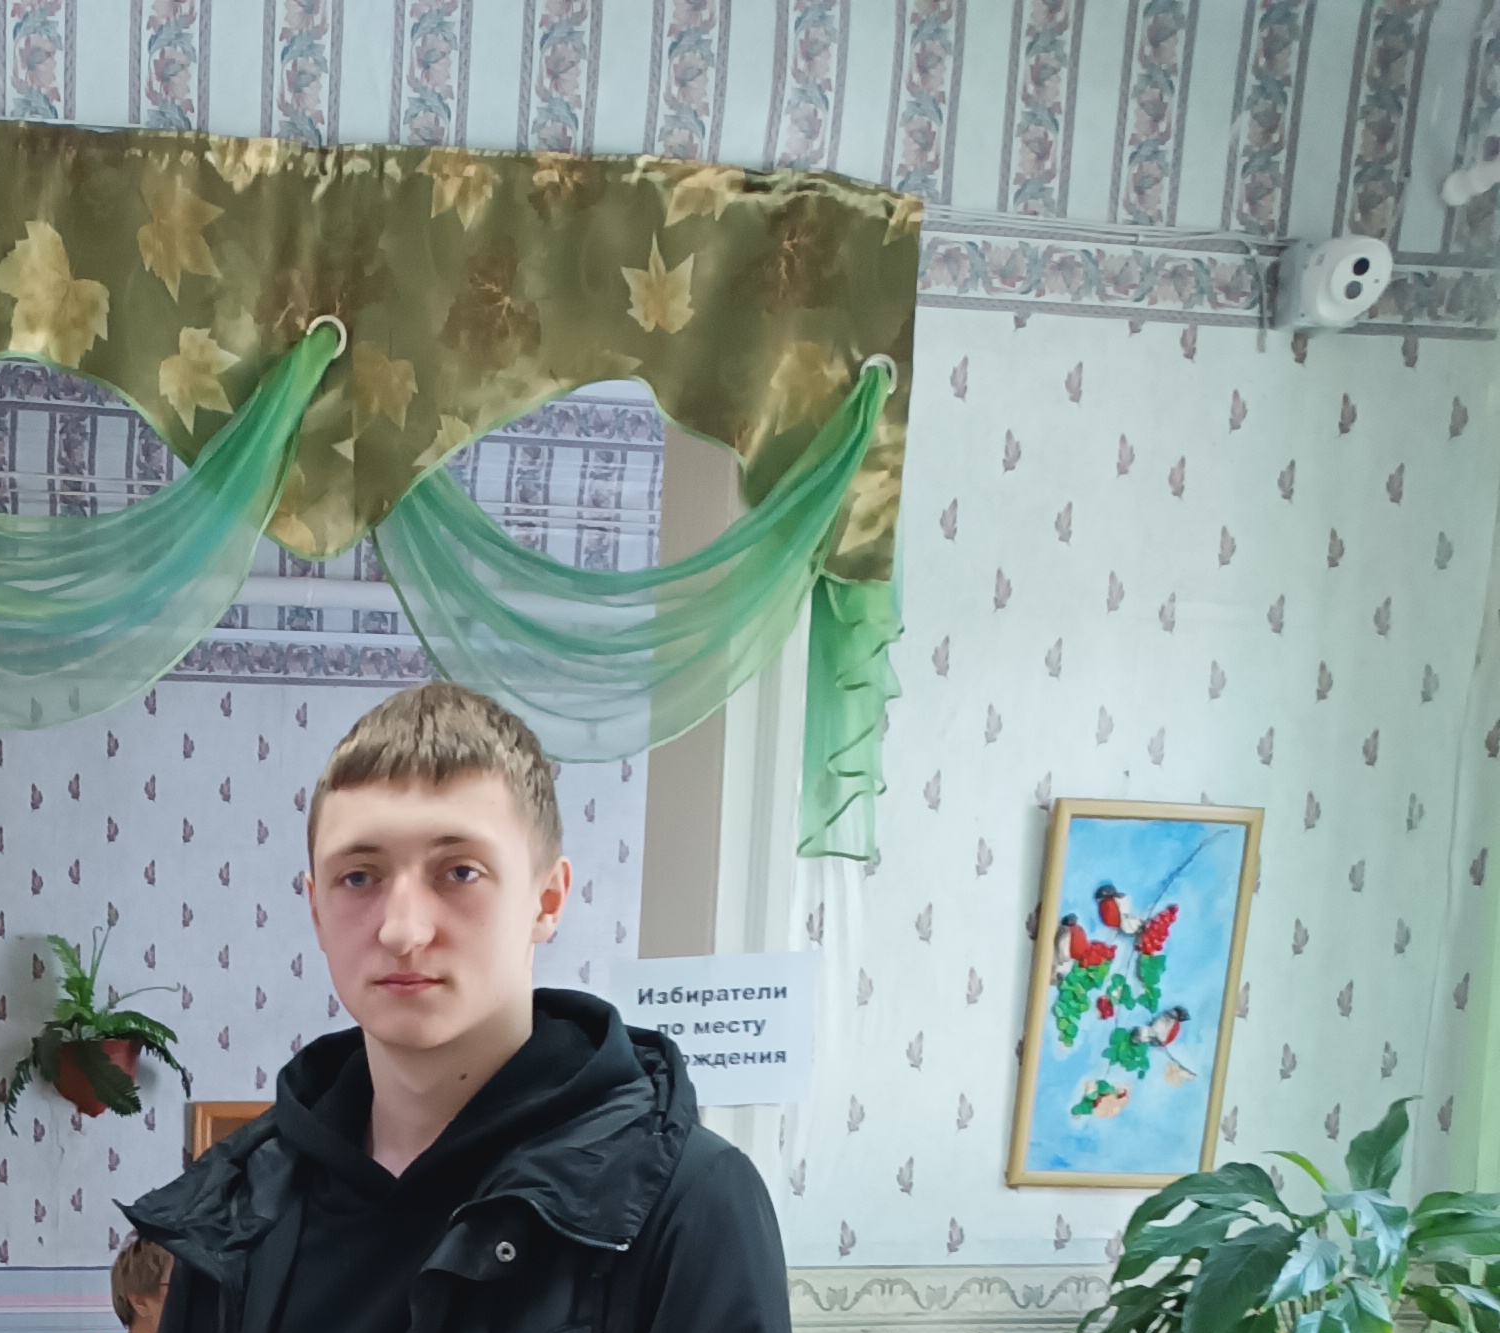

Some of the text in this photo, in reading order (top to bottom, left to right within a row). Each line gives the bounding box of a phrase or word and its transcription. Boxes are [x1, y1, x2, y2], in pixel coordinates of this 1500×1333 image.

[637, 986, 788, 1007] Избиратели
[657, 1019, 767, 1038] по месту
[681, 1050, 787, 1069] ождения
